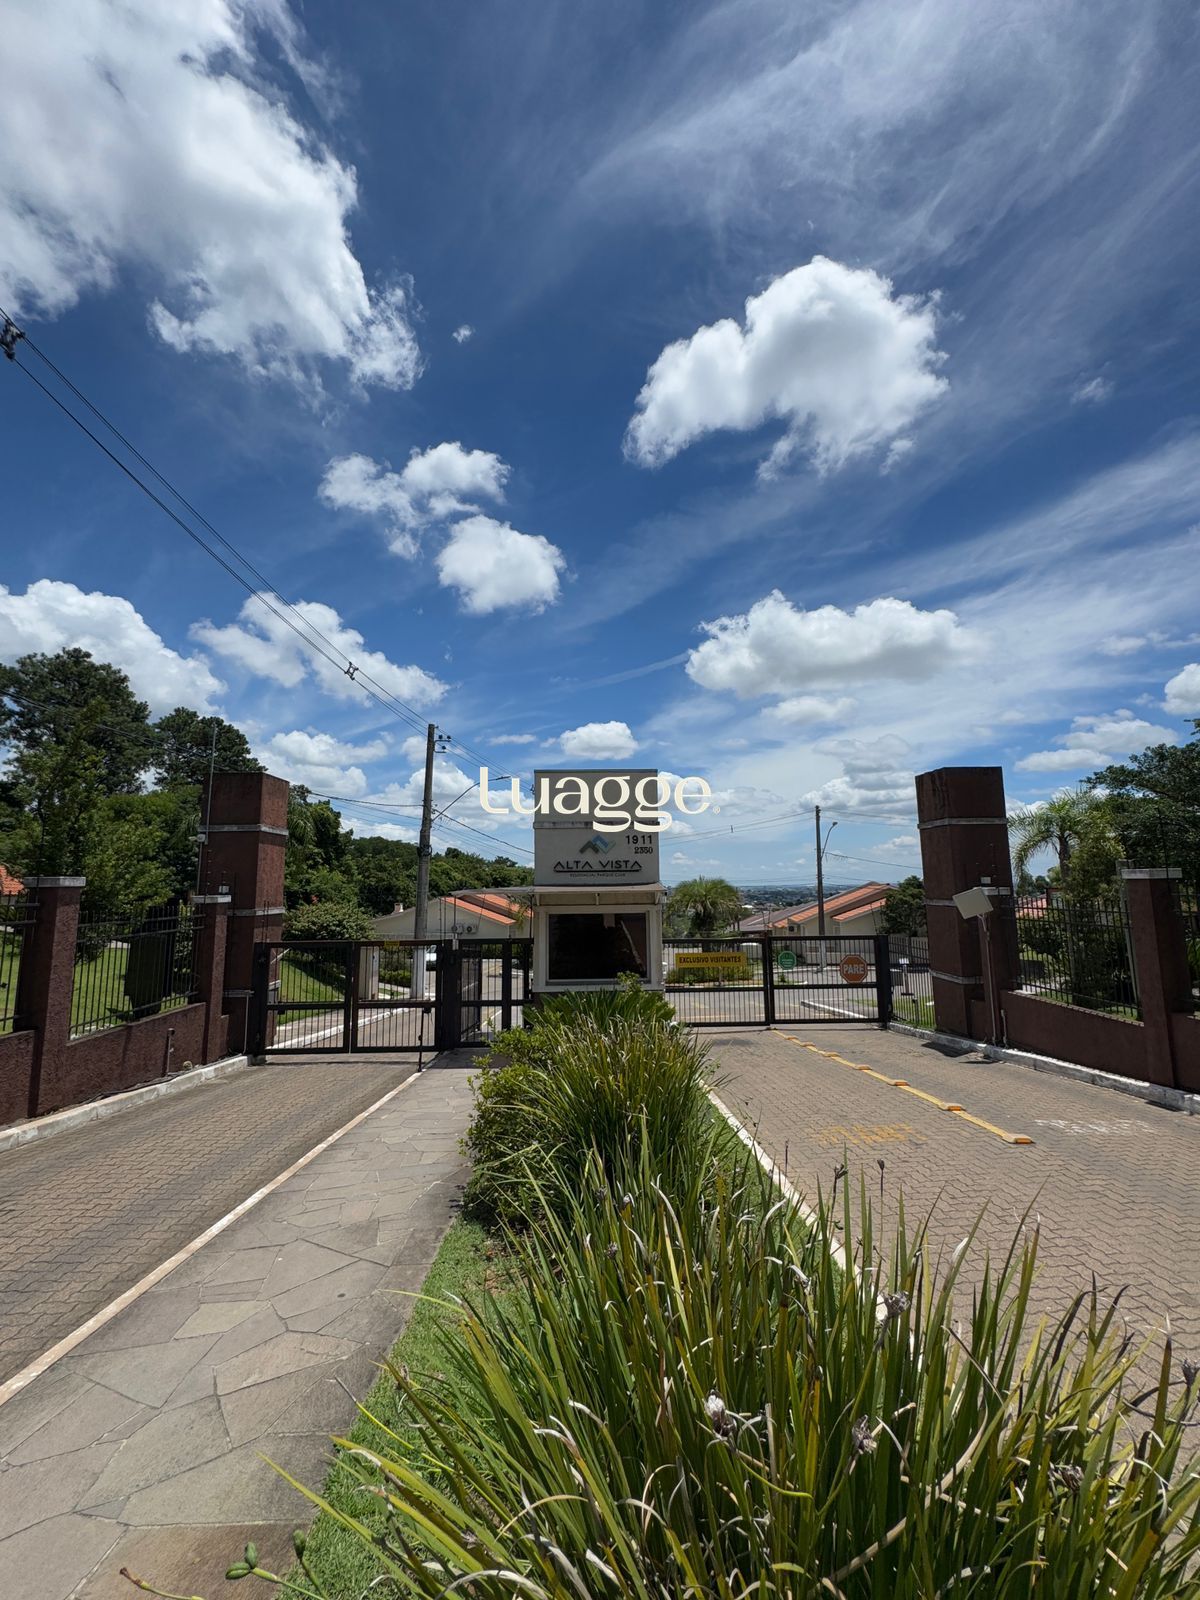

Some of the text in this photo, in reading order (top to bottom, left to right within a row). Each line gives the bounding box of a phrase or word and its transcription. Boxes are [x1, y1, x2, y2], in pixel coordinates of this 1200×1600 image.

[625, 834, 653, 845] 1911
[634, 846, 653, 855] 2350
[553, 860, 643, 870] ALTA VISTA
[679, 955, 742, 964] EXCLUSIVO VISITANTES
[843, 963, 865, 974] PARE
